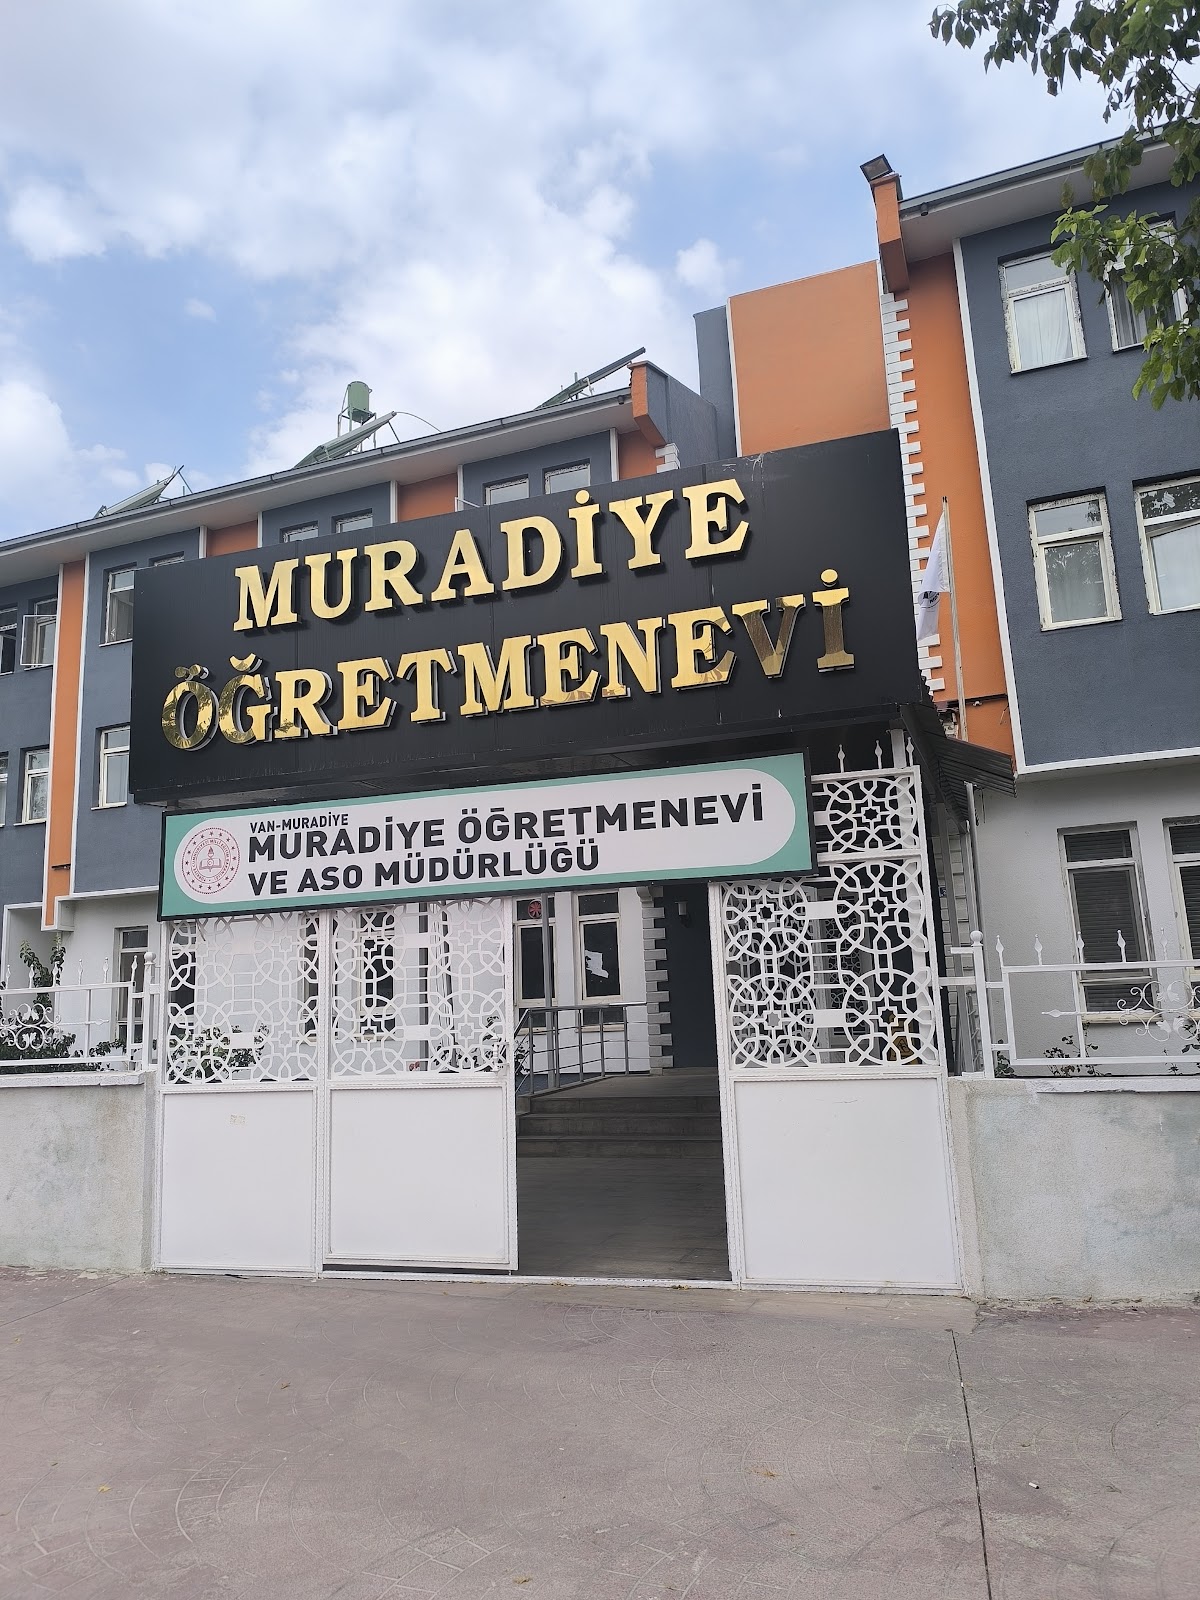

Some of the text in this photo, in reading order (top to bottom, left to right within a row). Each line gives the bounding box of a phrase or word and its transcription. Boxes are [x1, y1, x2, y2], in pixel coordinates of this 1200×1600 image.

[233, 478, 750, 632] MURADİYE
[161, 568, 856, 751] ÖĞRETMENEVİ
[248, 816, 445, 863] MURADİYE
[458, 783, 763, 844] ÖĞRETMENEVİ
[250, 811, 349, 834] VAN-MURADİYE
[248, 838, 599, 896] VE ASO MÜDÜRLÜĞÜ
